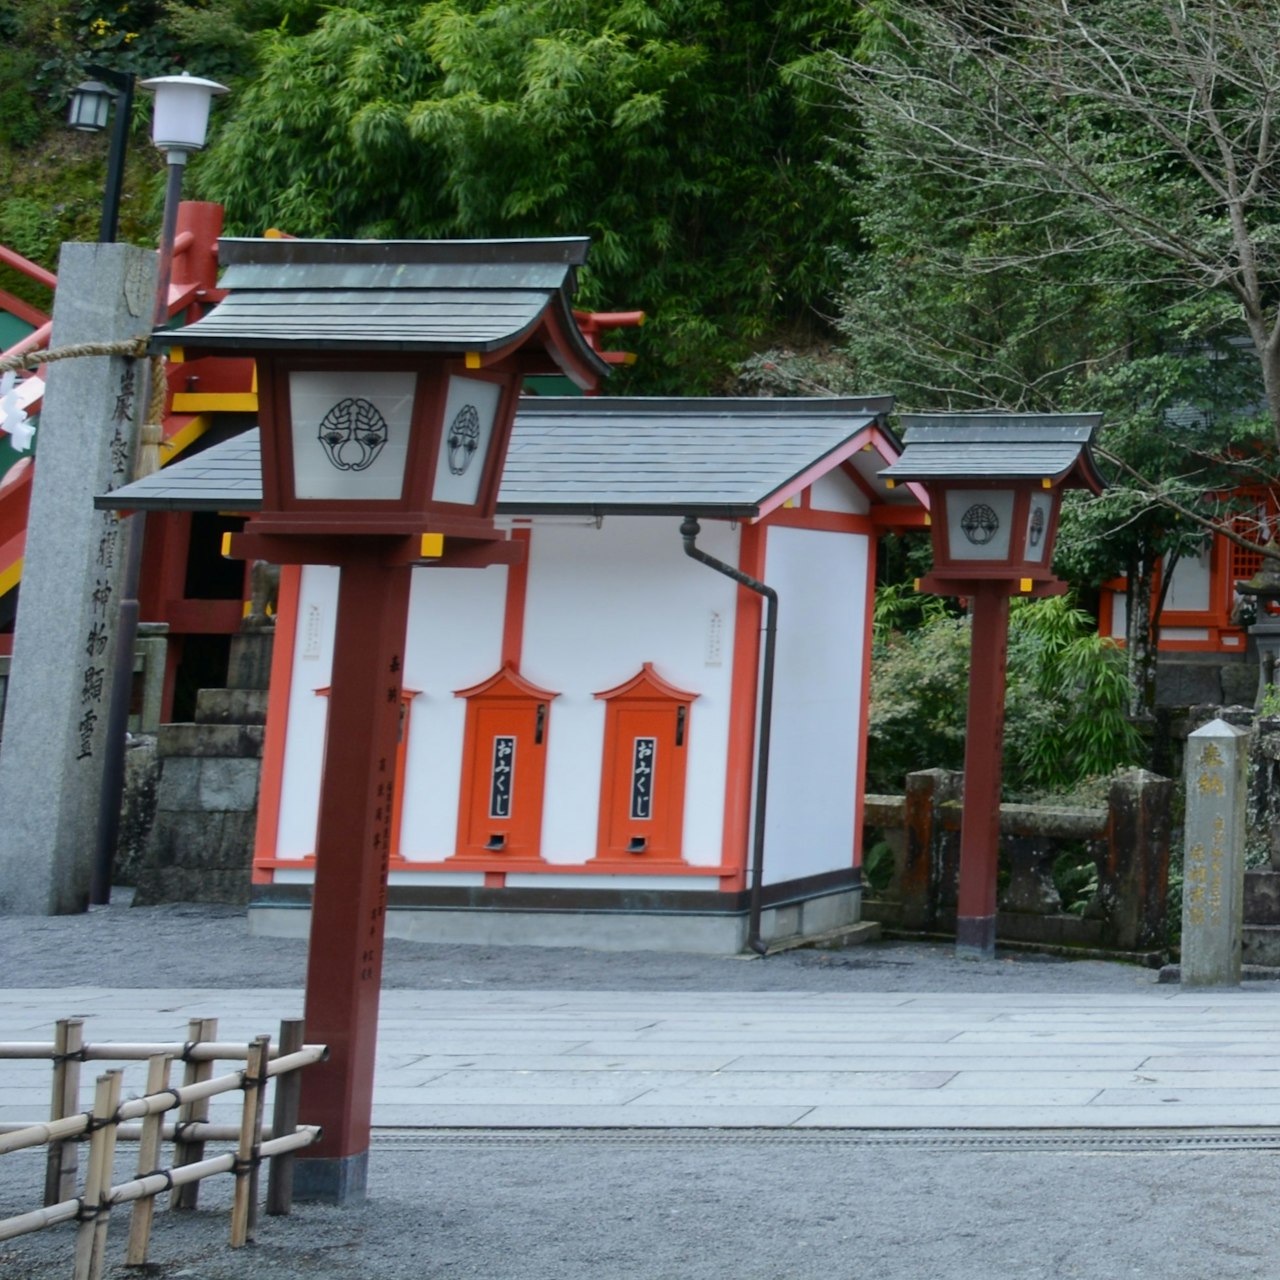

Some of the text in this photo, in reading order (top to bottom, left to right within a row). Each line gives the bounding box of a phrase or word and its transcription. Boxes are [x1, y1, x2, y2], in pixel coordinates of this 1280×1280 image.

[495, 740, 513, 816] おみくじ
[635, 741, 654, 818] おみくじ
[1198, 742, 1225, 797] 奉納
